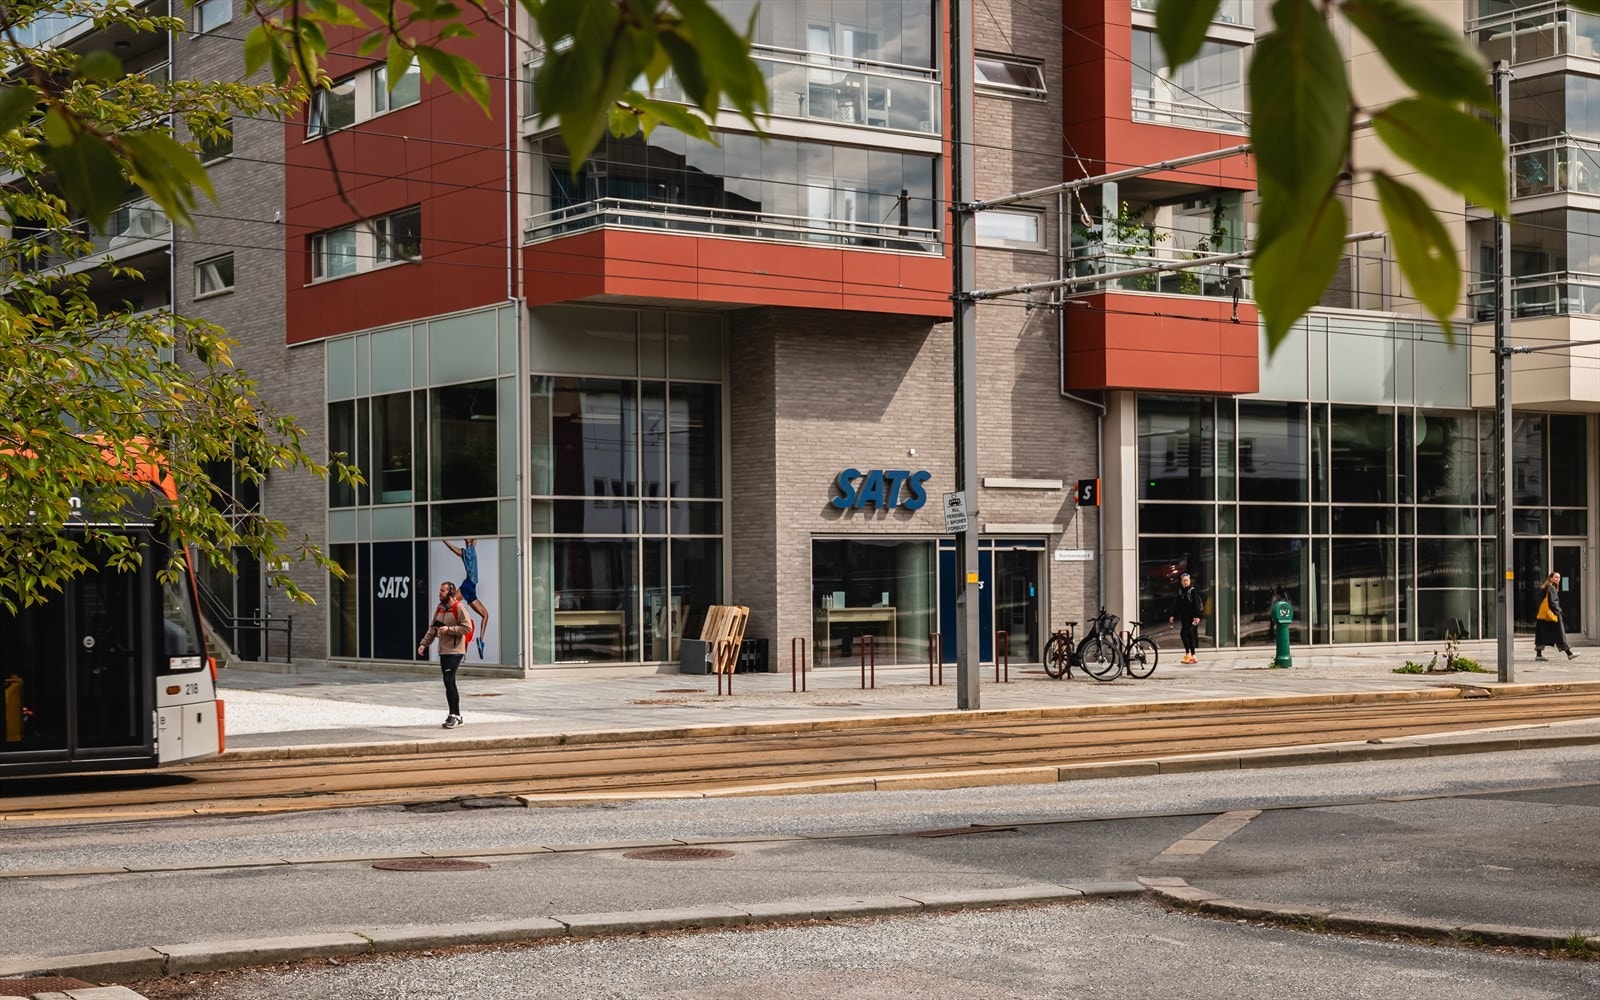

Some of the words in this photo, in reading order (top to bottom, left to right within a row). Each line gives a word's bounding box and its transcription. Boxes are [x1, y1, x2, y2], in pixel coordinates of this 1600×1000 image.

[831, 468, 932, 510] SATS
[1082, 485, 1092, 500] S
[377, 576, 411, 599] SATS
[185, 683, 199, 695] 218
